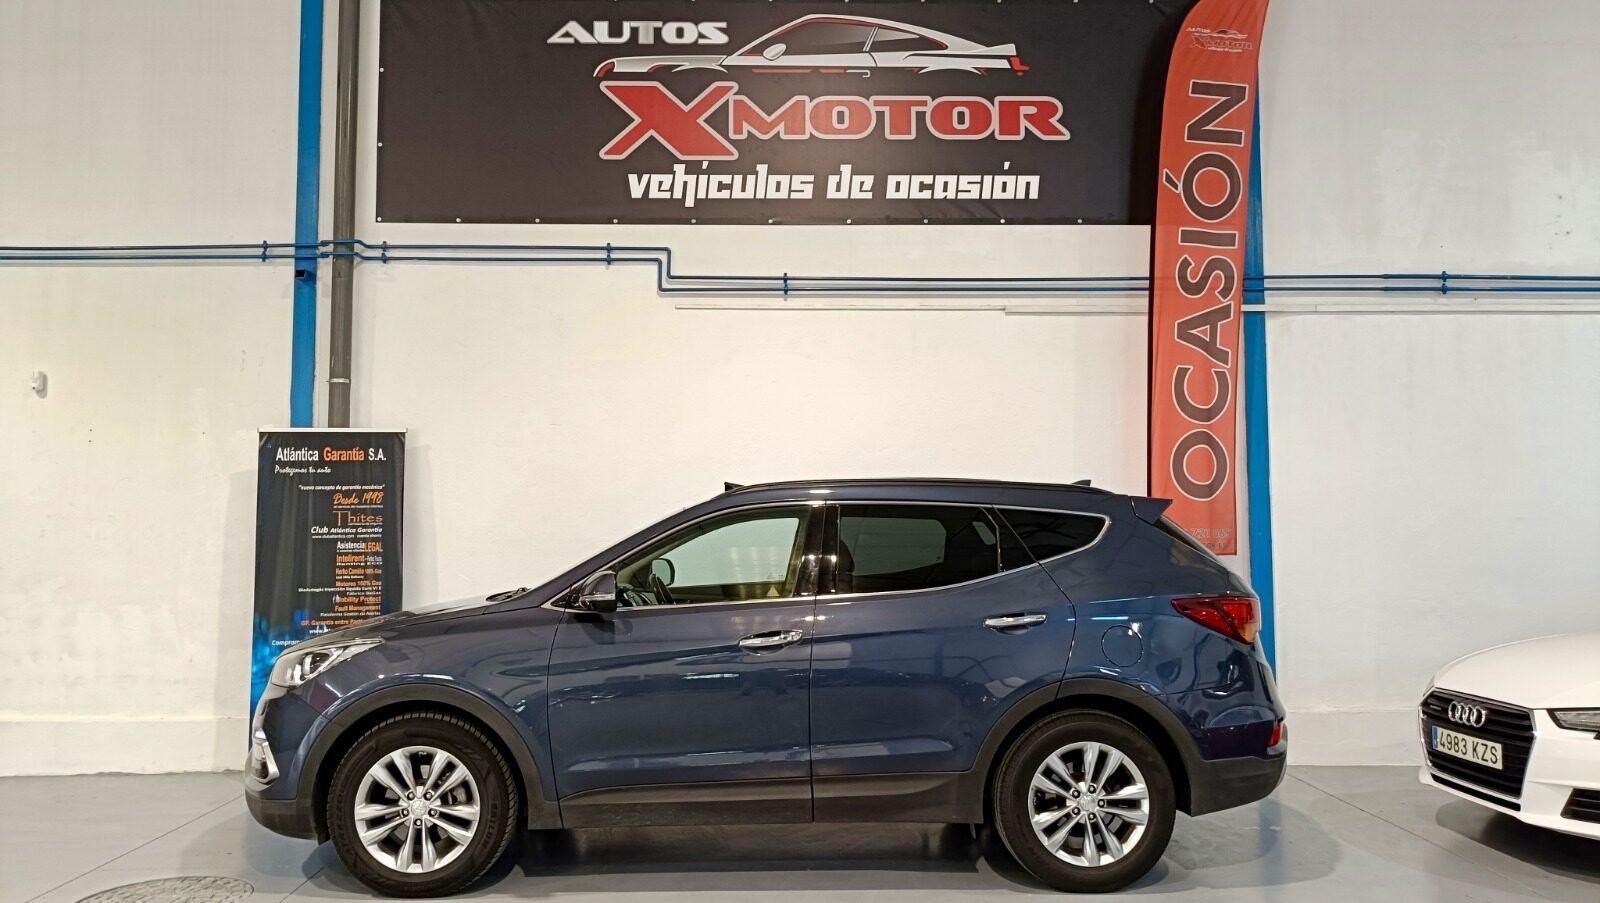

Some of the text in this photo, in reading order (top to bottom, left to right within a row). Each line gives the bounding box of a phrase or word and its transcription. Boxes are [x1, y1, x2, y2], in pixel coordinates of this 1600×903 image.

[546, 20, 731, 46] AUTOS
[599, 80, 1071, 160] XMOTOR
[627, 161, 1041, 208] vehículos de ocasión
[1163, 79, 1249, 502] OCASIÓN
[276, 446, 387, 461] Atlántica Garantía S.A.
[333, 491, 385, 504] Desde 1998
[311, 525, 329, 534] Club
[336, 541, 383, 552] Asistencia LEGAL
[1440, 731, 1468, 756] 4983
[1472, 740, 1498, 765] KZS
